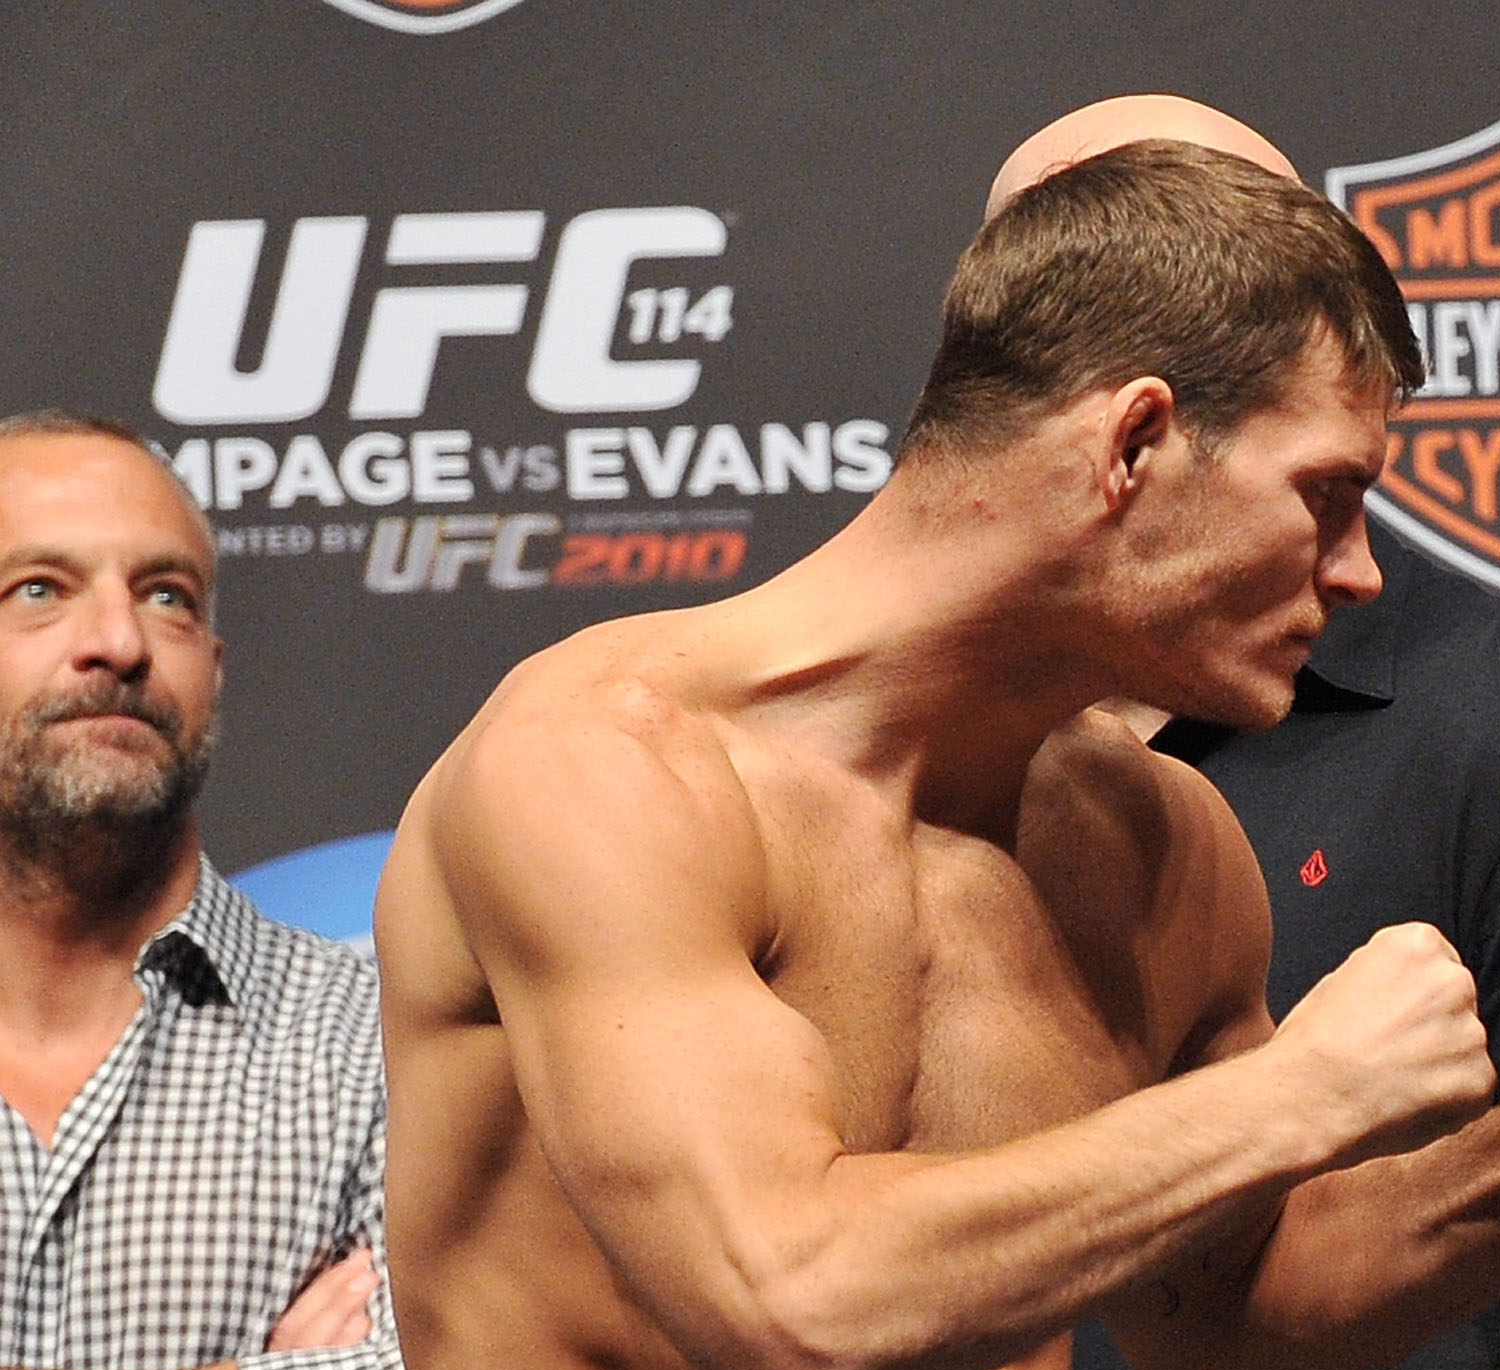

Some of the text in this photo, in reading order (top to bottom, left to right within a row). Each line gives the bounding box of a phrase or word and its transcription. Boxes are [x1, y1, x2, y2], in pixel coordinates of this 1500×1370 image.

[152, 206, 735, 425] UFC 114
[565, 418, 894, 500] EVANS
[320, 522, 370, 554] BY
[364, 512, 564, 594] UFC
[550, 528, 748, 588] 2010
